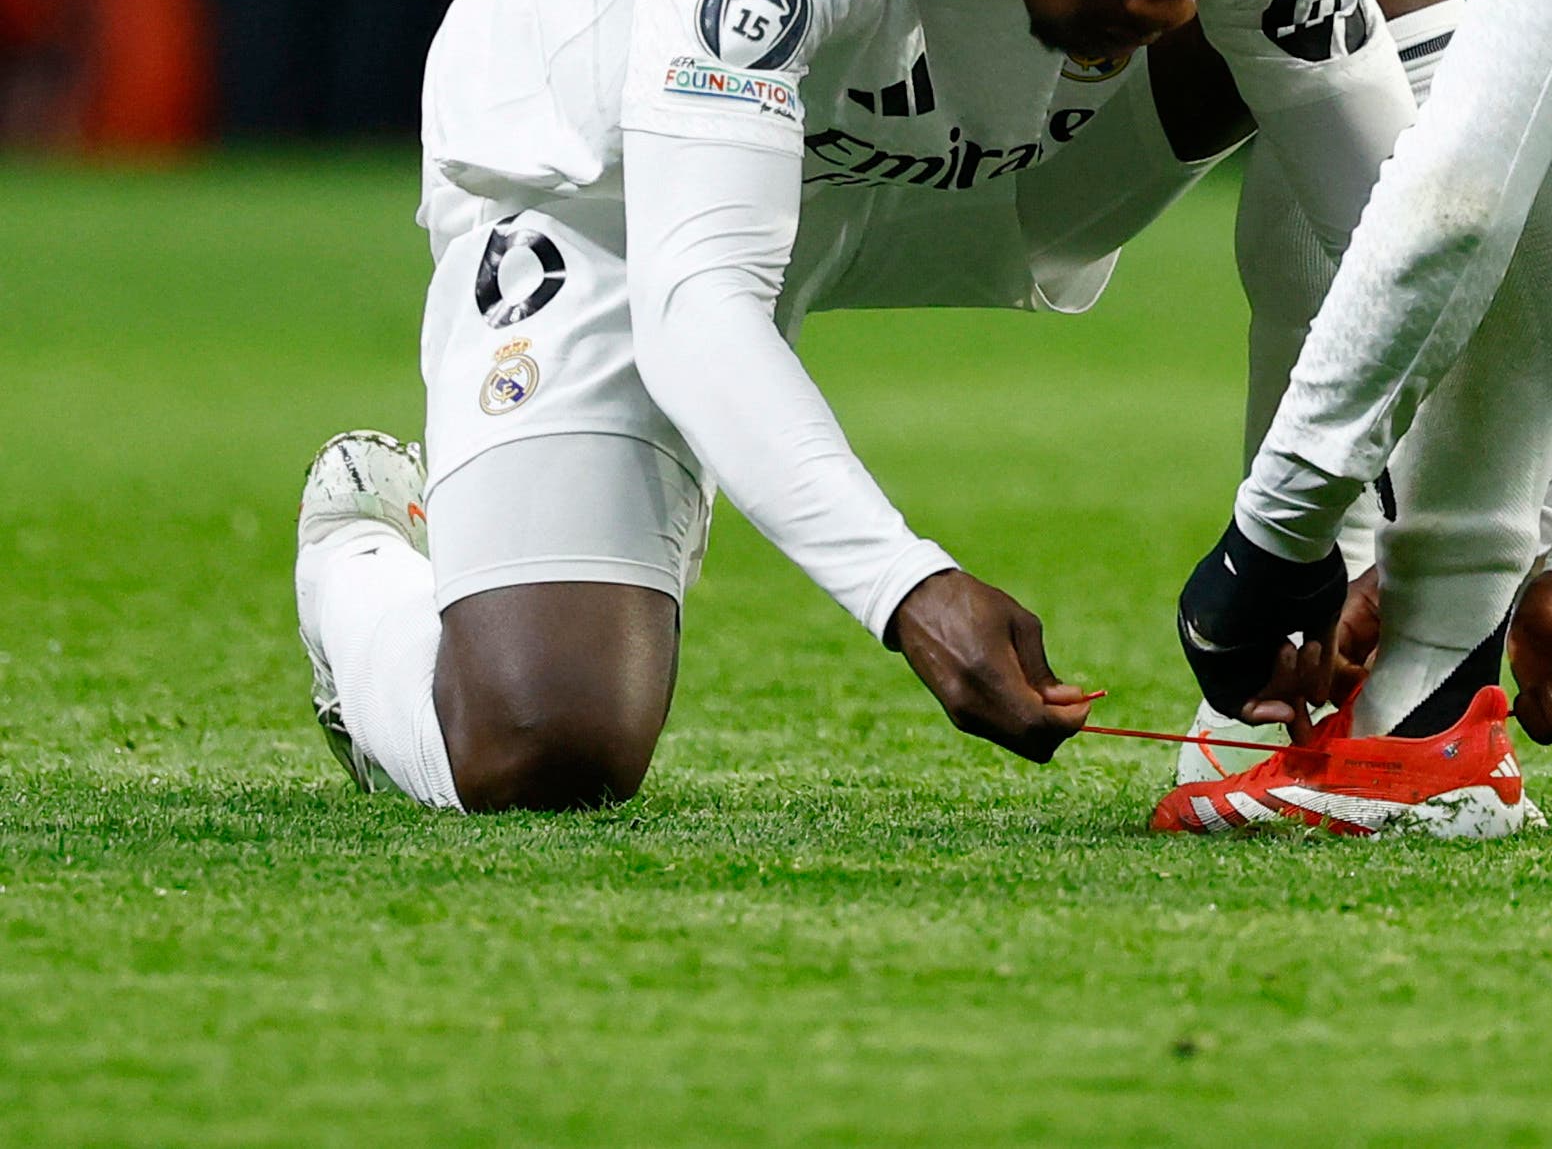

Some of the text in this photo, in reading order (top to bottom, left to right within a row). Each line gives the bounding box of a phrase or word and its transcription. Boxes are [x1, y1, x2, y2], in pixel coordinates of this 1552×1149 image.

[732, 8, 770, 42] 15
[670, 56, 696, 69] UEFA
[664, 69, 797, 111] FOUNDATION
[803, 108, 1095, 190] Emirae
